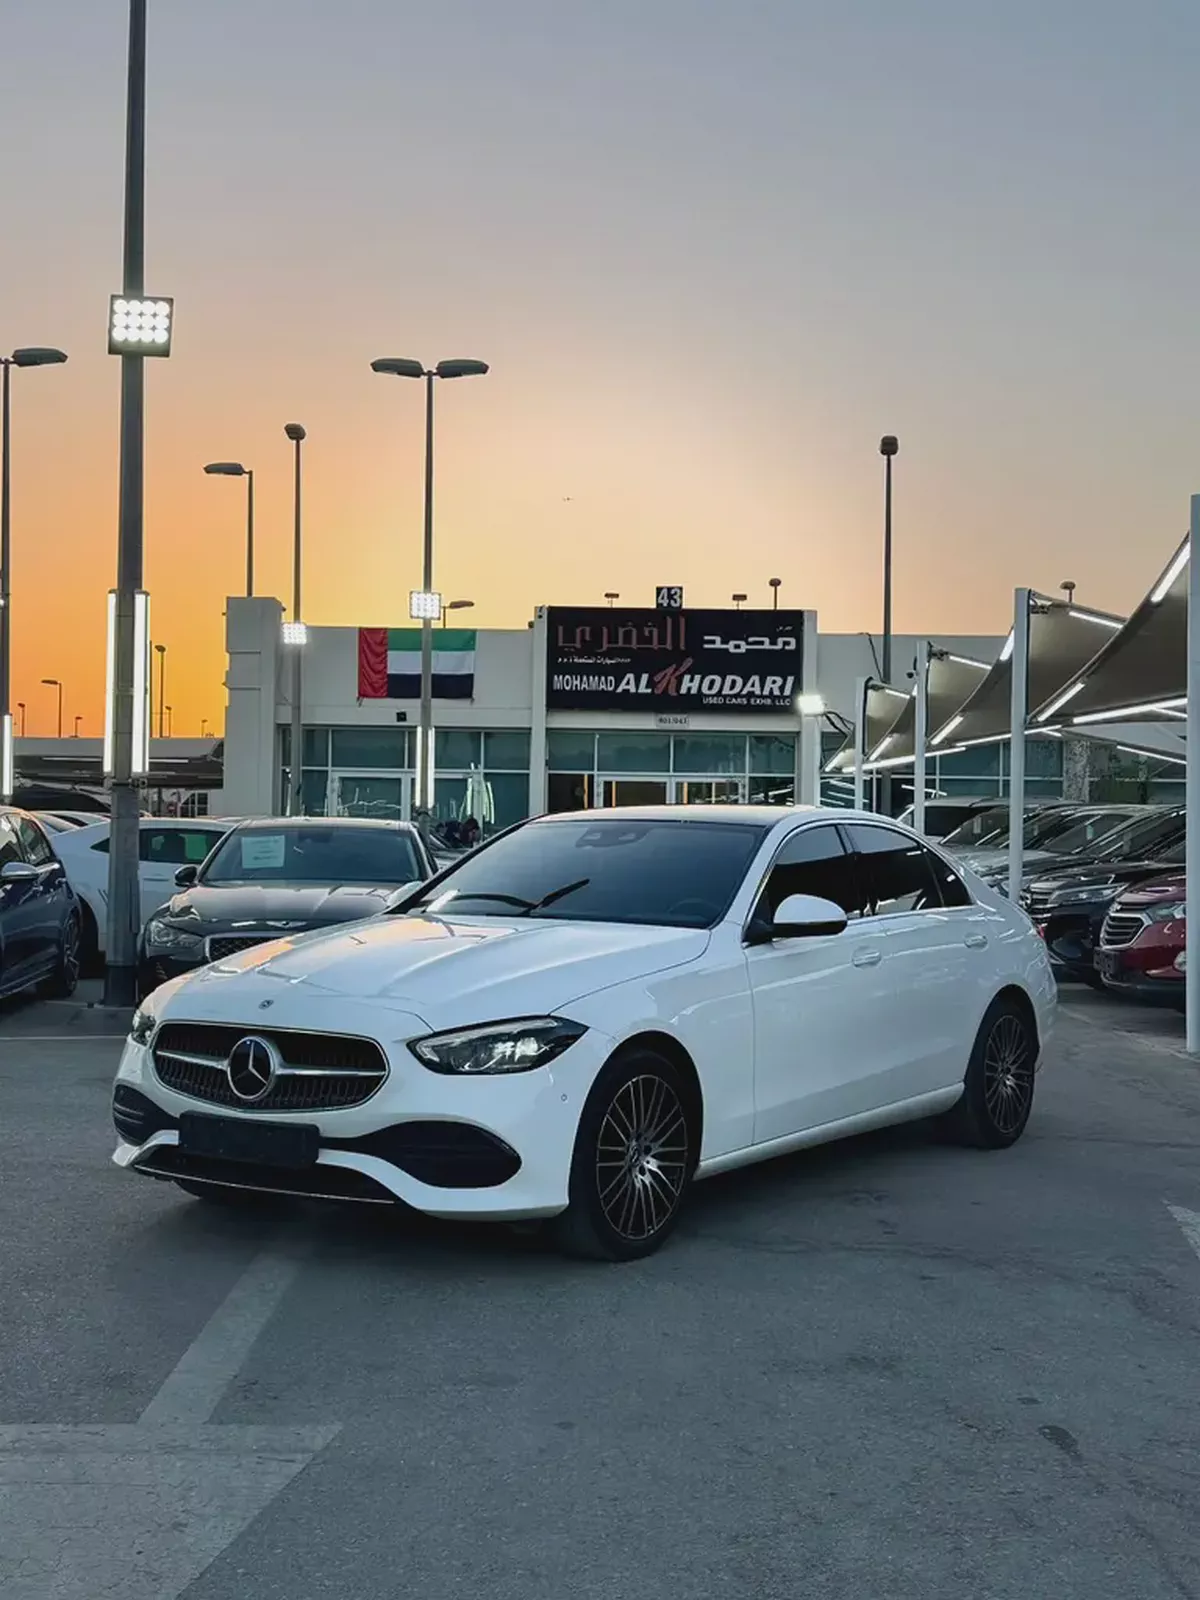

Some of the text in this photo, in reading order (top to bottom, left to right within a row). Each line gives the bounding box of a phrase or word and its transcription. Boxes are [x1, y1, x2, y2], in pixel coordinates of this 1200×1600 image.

[658, 587, 681, 607] 43
[553, 674, 615, 691] MOHAMAD
[703, 696, 724, 704] USED
[726, 696, 747, 704] CARS
[776, 697, 791, 706] LLC
